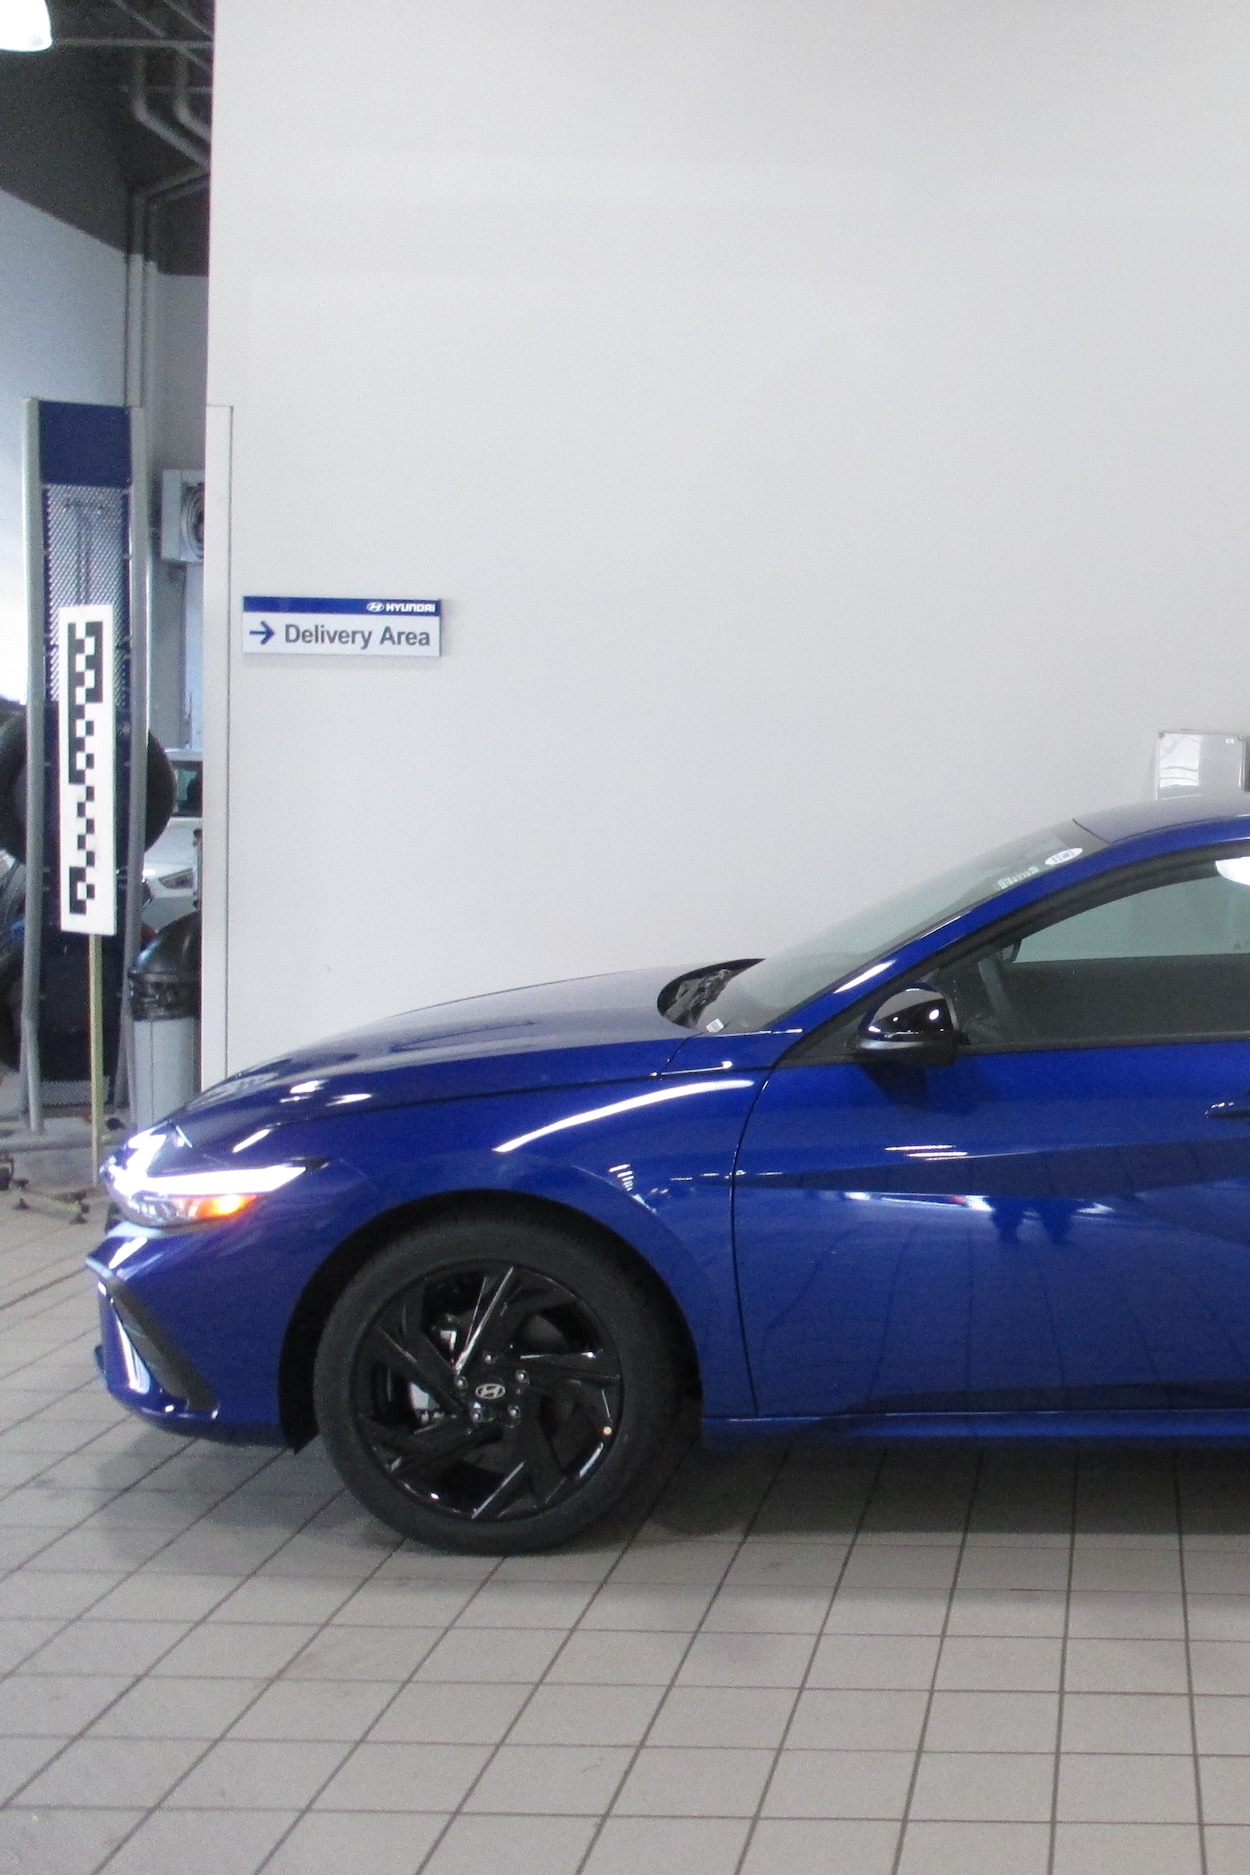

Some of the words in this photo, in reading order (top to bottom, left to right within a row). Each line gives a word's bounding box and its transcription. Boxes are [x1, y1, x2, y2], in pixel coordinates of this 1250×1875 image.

[386, 603, 436, 613] HYUNDAI
[285, 624, 372, 650] Delivery
[379, 625, 431, 647] Area
